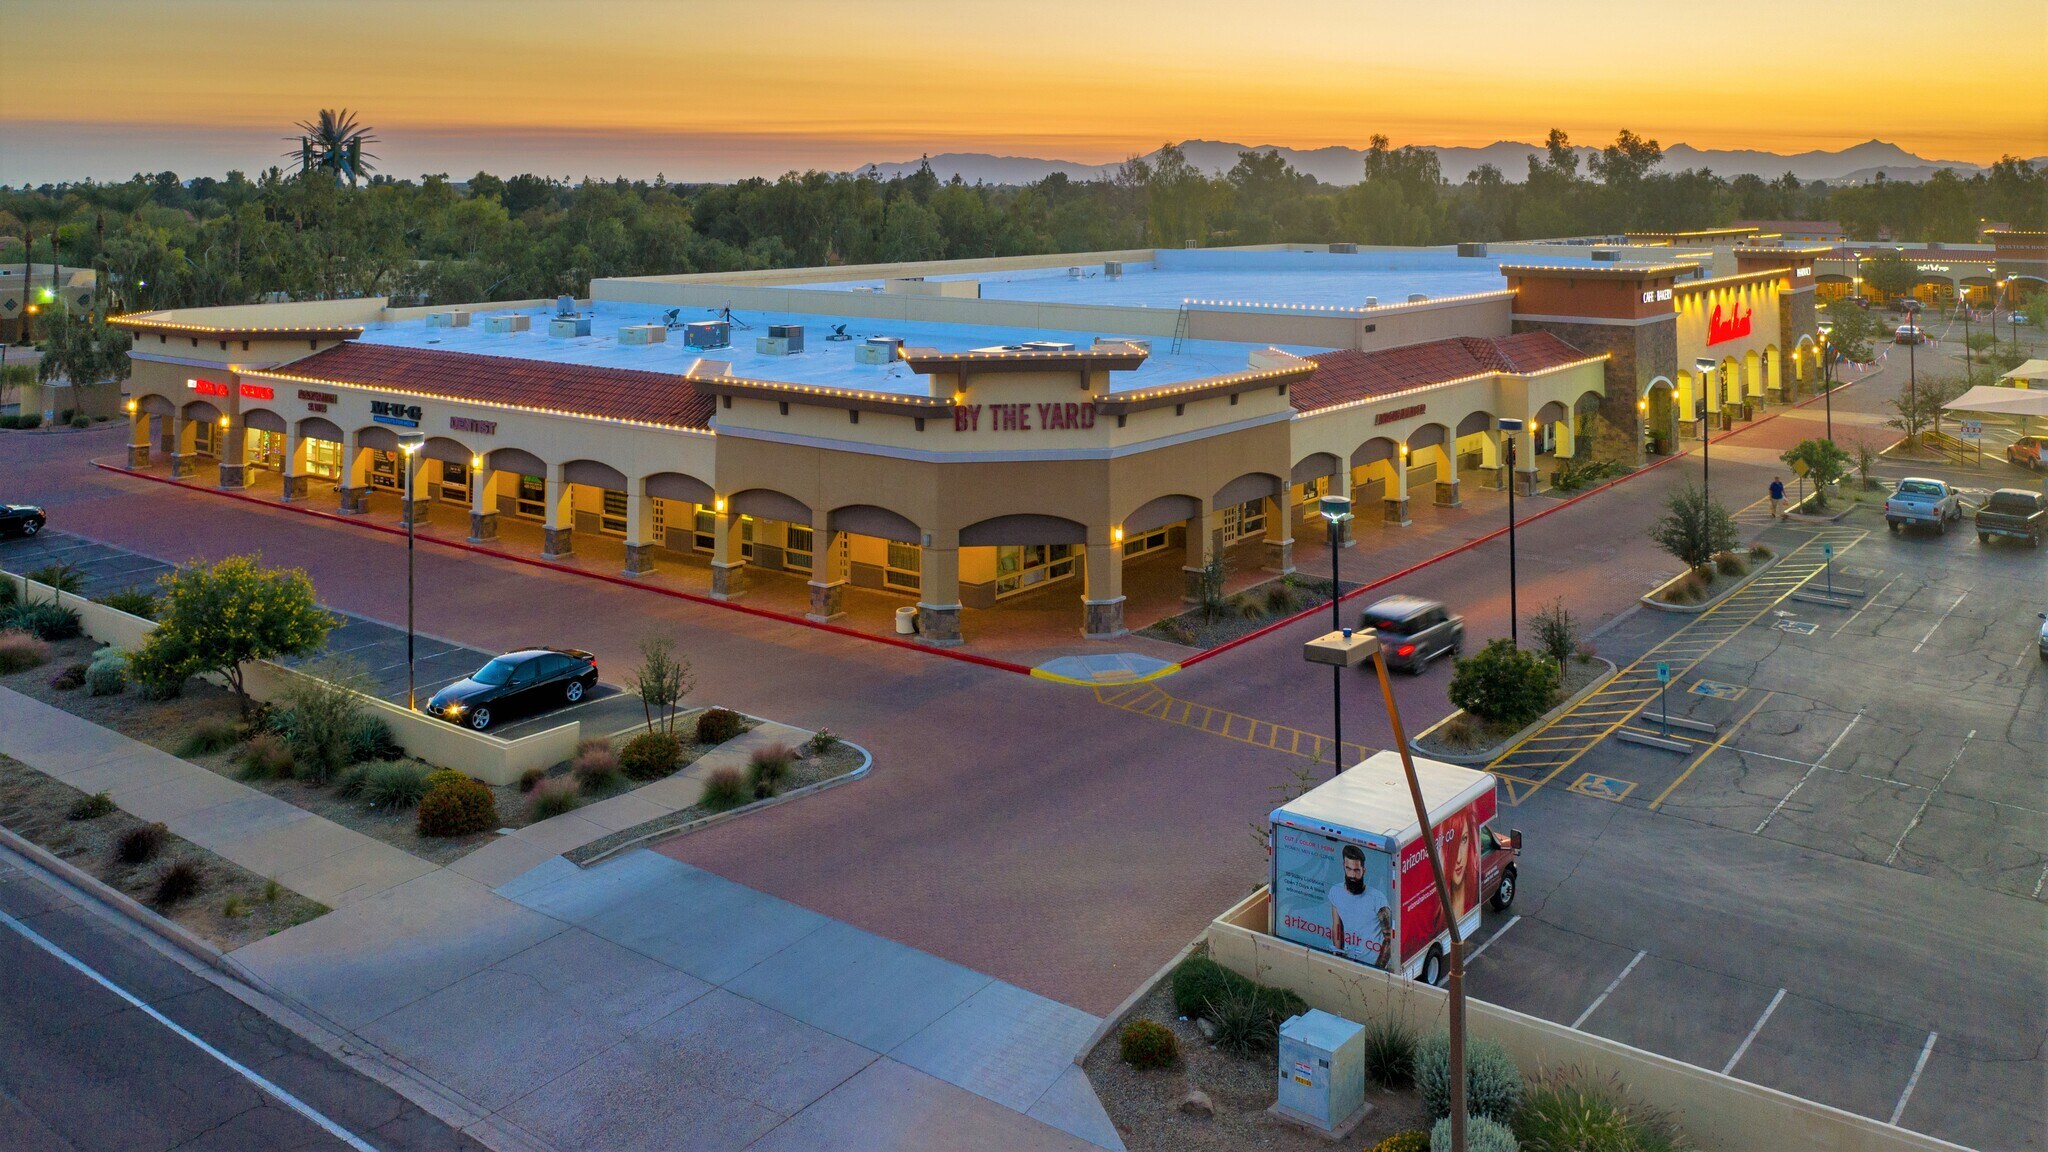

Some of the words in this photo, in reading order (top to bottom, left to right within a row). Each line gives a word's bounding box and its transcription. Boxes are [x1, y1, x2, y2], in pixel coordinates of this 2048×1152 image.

[195, 378, 216, 396] SPA
[240, 383, 274, 401] NAILS
[450, 416, 497, 435] DENTIST
[953, 404, 982, 433] BY
[989, 403, 1032, 432] THE
[1037, 401, 1096, 431] YARD
[1445, 828, 1455, 843] co
[1299, 839, 1316, 847] COLOR
[1320, 845, 1335, 853] PERM
[1299, 882, 1310, 890] Days
[1284, 914, 1333, 940] arizona
[1365, 939, 1384, 953] co
